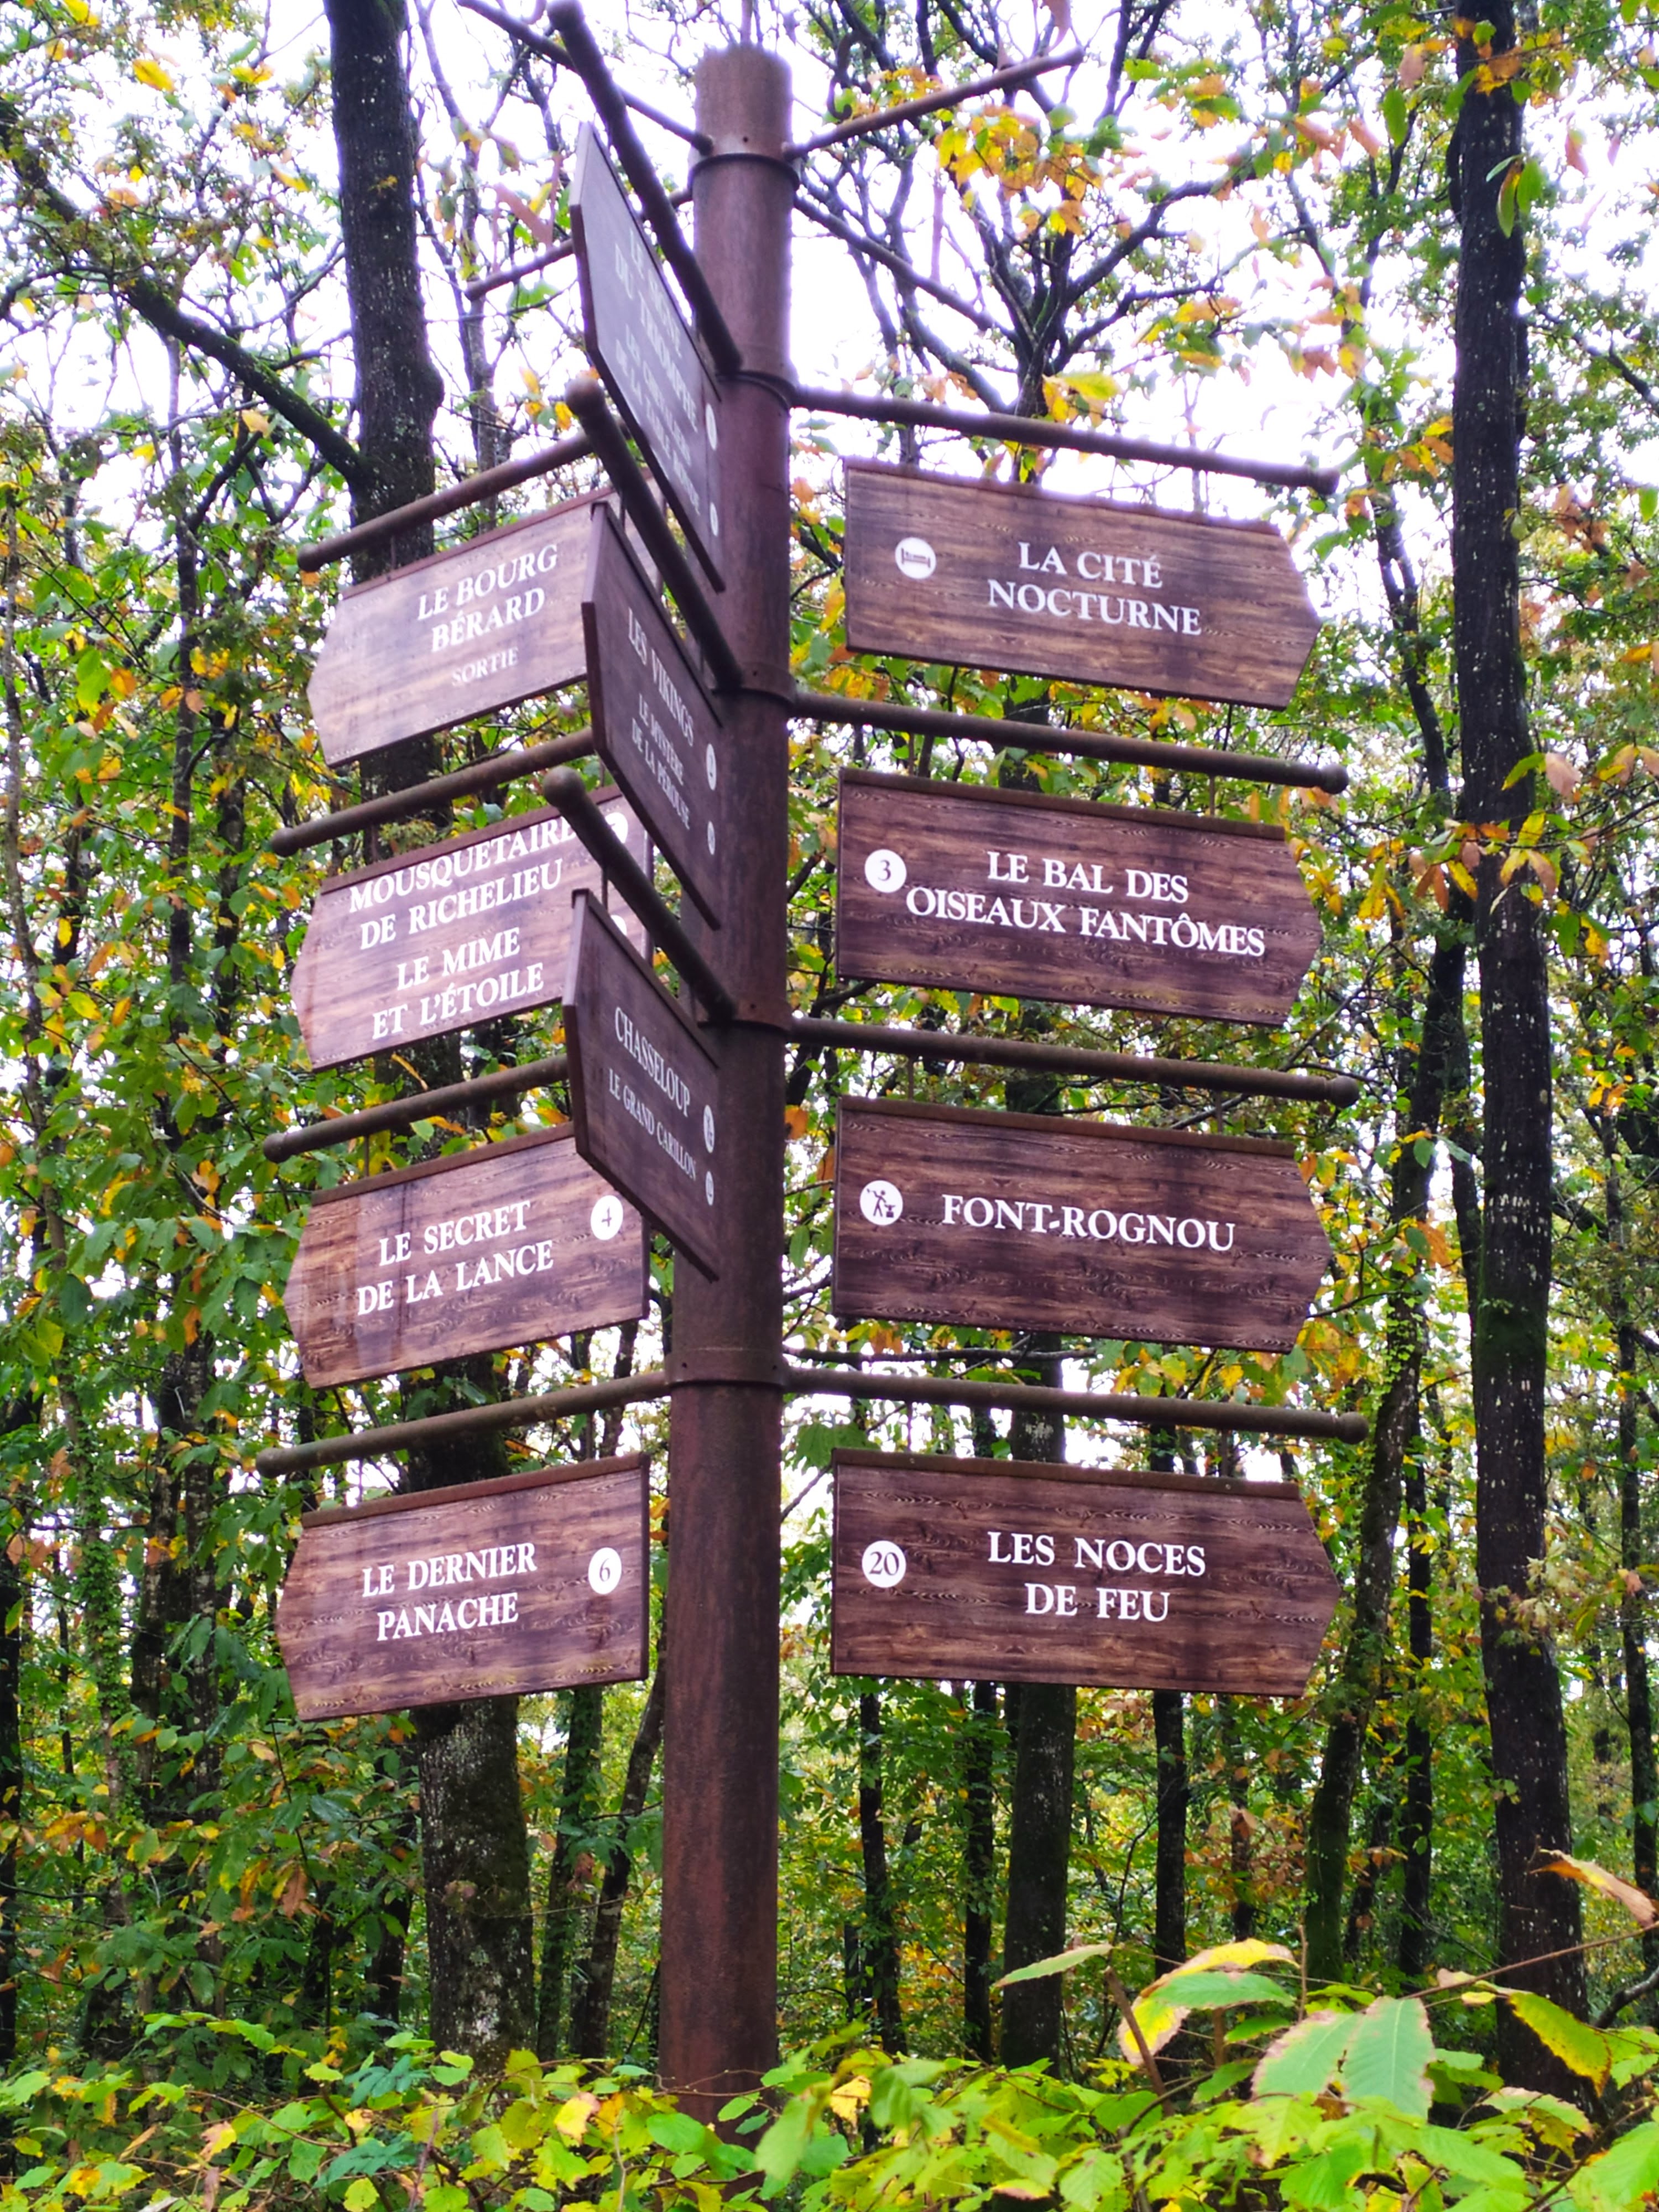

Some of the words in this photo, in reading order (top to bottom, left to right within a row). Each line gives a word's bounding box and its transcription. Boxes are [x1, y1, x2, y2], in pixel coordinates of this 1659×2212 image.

[615, 243, 633, 299] DU
[630, 228, 644, 280] LE
[631, 368, 643, 405] LA
[418, 587, 448, 620] LE
[455, 544, 557, 607] BOURG
[1019, 542, 1067, 575] LA
[1077, 552, 1162, 588] CITÉ
[431, 587, 545, 653] BÉRARD
[988, 579, 1201, 635] NOCTURNE
[451, 648, 518, 687] SORTIE
[628, 608, 648, 666] LES
[651, 648, 693, 747] VIKINGS
[639, 694, 649, 727] LE
[631, 717, 644, 752] DE
[645, 740, 656, 774] LA
[878, 859, 891, 882] 3
[987, 851, 1029, 883] LE
[1042, 858, 1113, 894] BAL
[1125, 869, 1188, 903] DES
[359, 914, 397, 950] DE
[409, 858, 563, 935] RICHELIEU
[906, 887, 1066, 932] OISEAUX
[1079, 907, 1265, 956] FANTÔMES
[396, 956, 431, 991] LE
[441, 927, 520, 978] MIME
[372, 1003, 408, 1040] ET
[419, 962, 544, 1026] L'ÉTOILE
[615, 1006, 691, 1117] CHASSELOUP
[609, 1068, 620, 1100] LE
[623, 1085, 654, 1135] GRAND
[656, 1121, 696, 1181] CARILLON
[378, 1232, 412, 1267] LE
[423, 1199, 531, 1255] SECRET
[601, 1206, 612, 1228] 4
[942, 1194, 1235, 1251] FONT-ROGNOU
[357, 1280, 394, 1316] DE
[405, 1270, 444, 1303] LA
[455, 1239, 554, 1291] LANCE
[362, 1564, 395, 1598] LE
[407, 1542, 538, 1591] DERNIER
[599, 1557, 611, 1582] 6
[869, 1551, 900, 1576] 20
[988, 1531, 1055, 1566] LES
[1074, 1537, 1205, 1576] NOCES
[377, 1592, 519, 1641] PANACHE
[1025, 1583, 1077, 1616] DE
[1096, 1588, 1170, 1621] FEU
